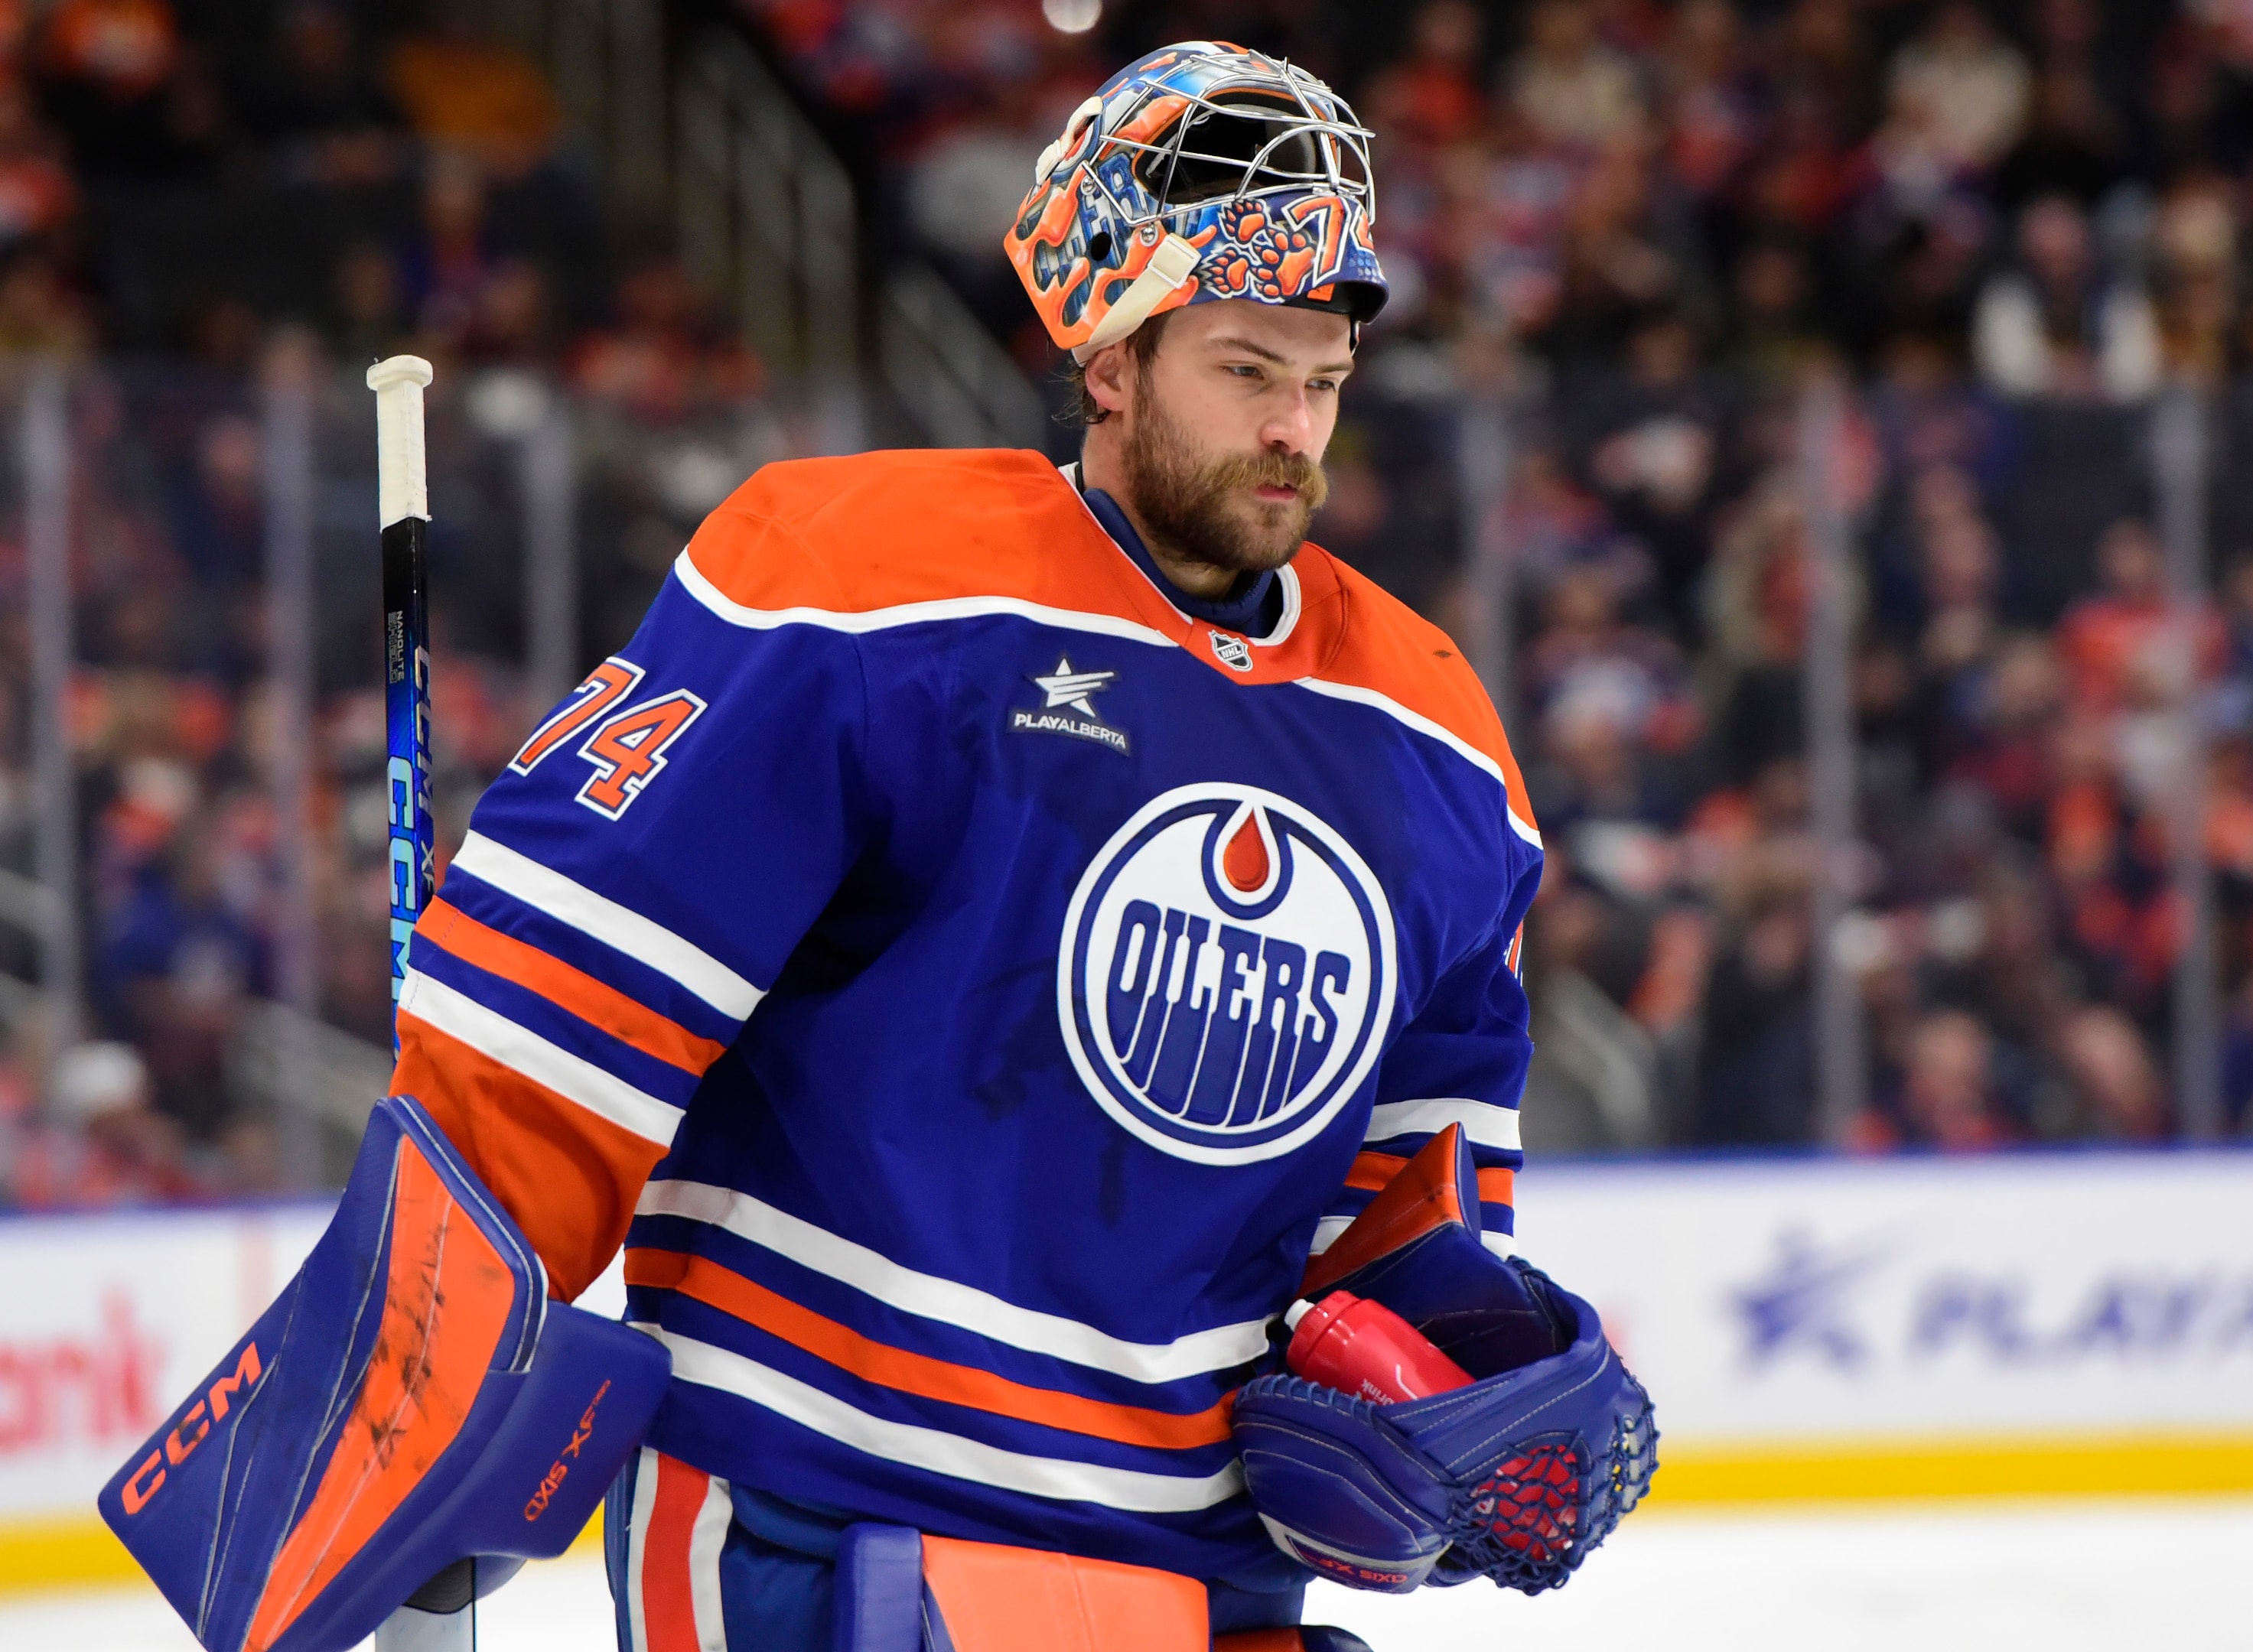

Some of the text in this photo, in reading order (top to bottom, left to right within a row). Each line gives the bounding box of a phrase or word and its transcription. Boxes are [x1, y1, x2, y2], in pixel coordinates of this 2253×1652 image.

[396, 610, 405, 682] NANOLITE
[507, 656, 708, 821] 74
[1014, 713, 1126, 750] PLAYALBERTA
[1106, 899, 1351, 1127] OILERS
[122, 1341, 262, 1515] CCM
